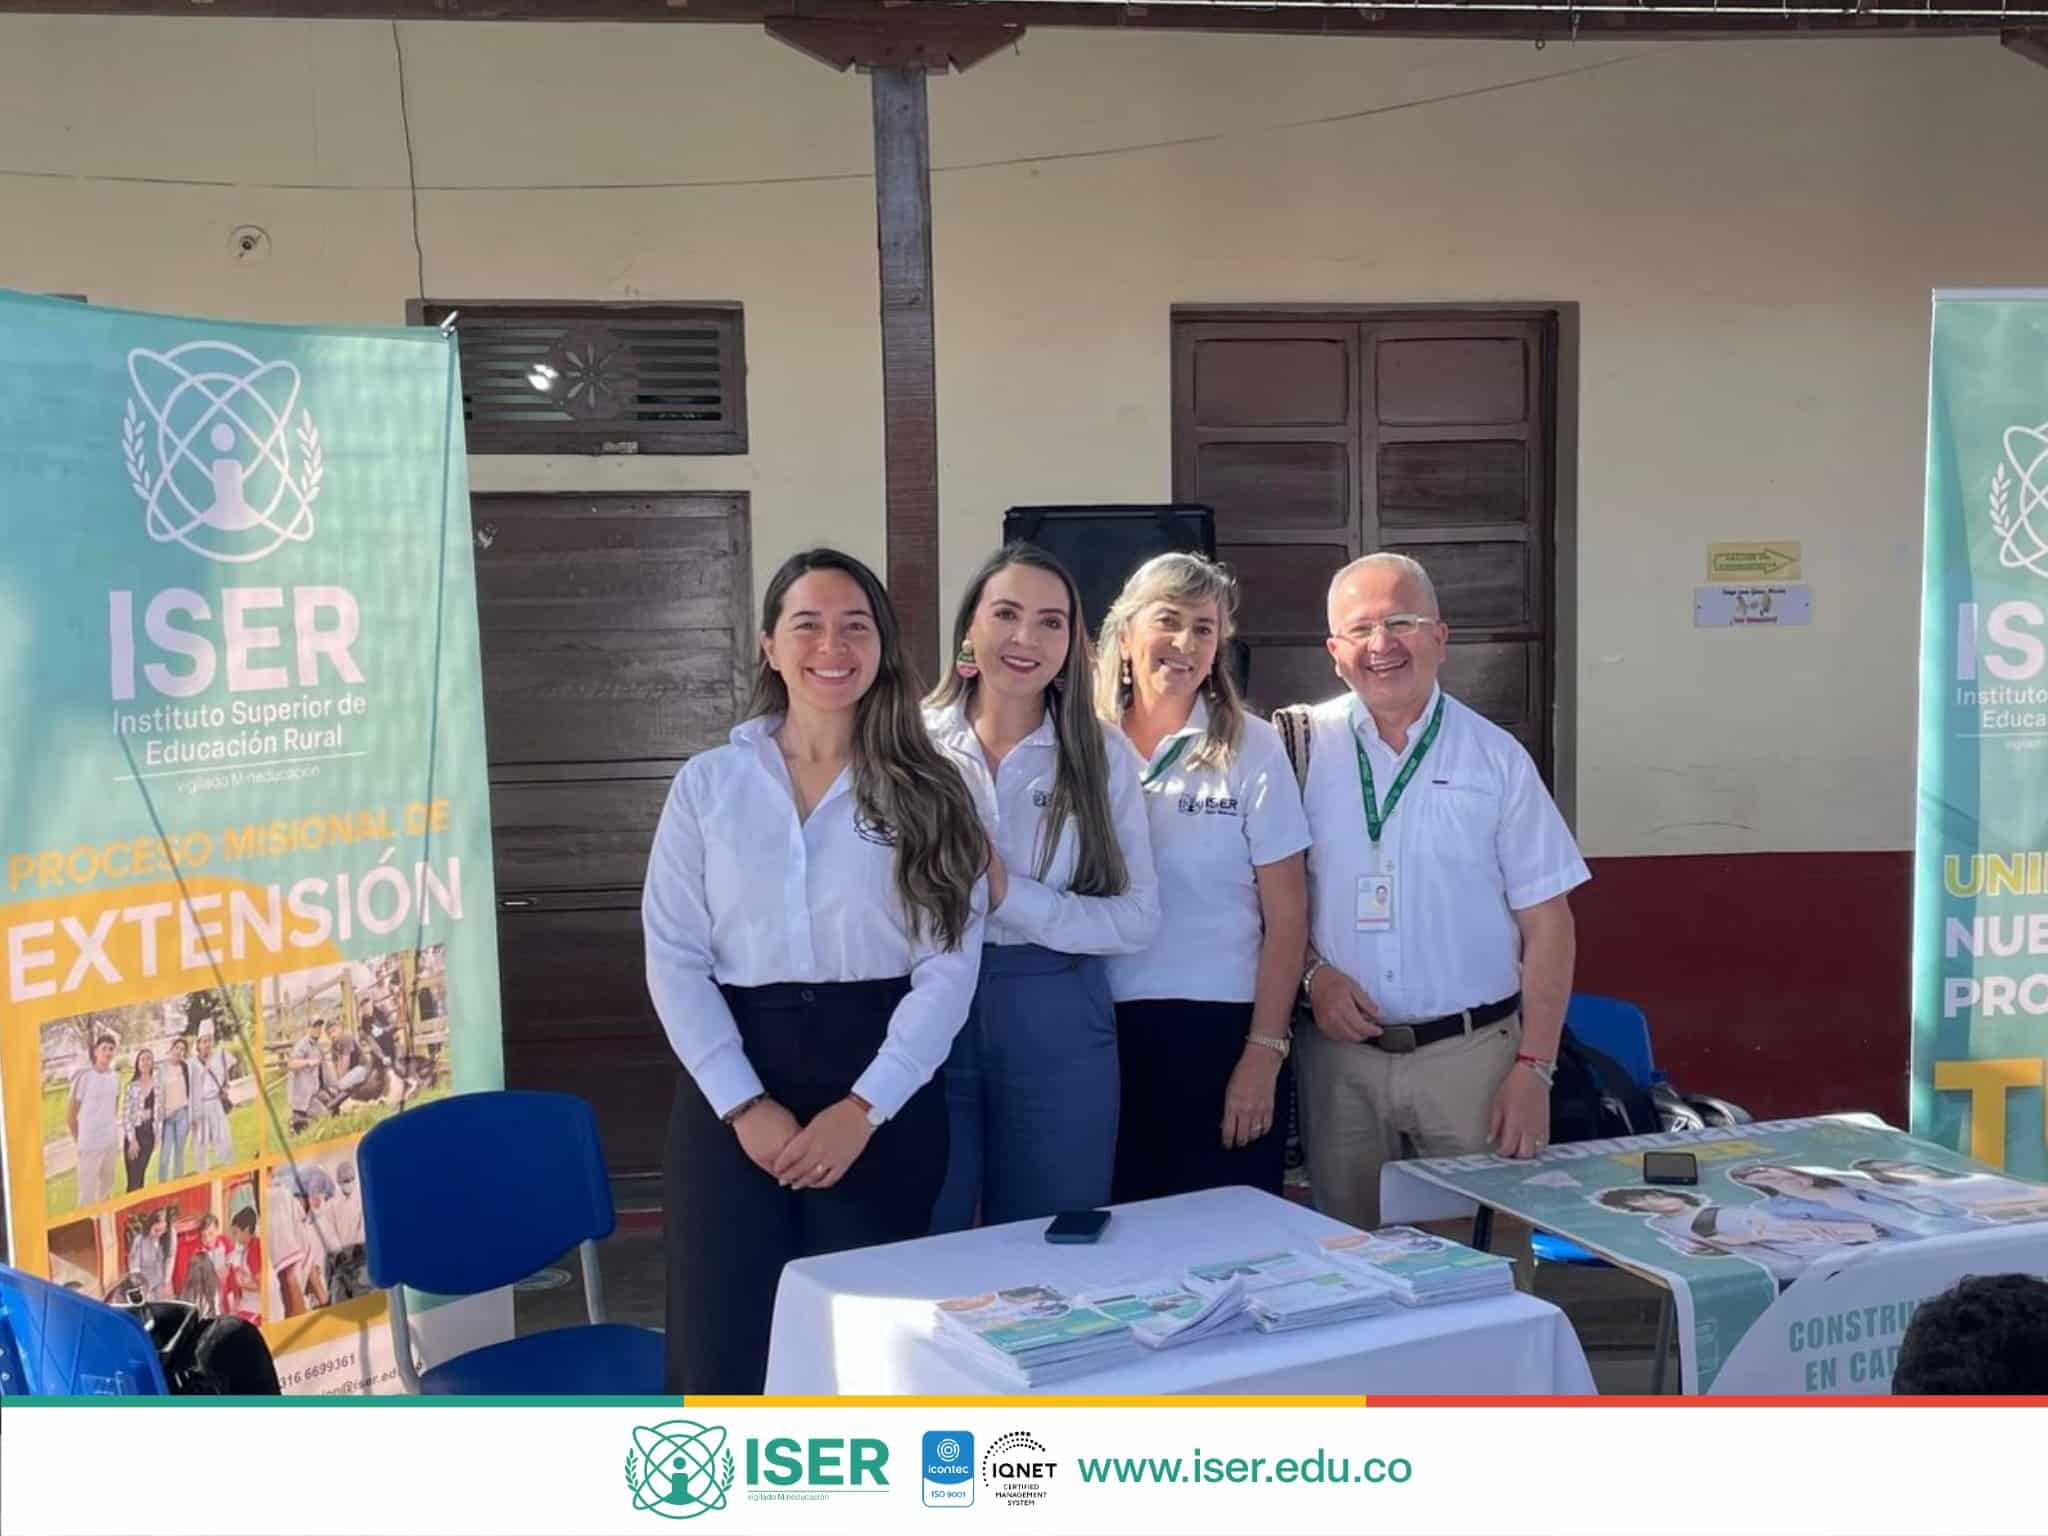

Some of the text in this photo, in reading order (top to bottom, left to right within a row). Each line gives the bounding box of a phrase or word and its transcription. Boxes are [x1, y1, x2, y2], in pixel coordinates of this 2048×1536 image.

[109, 585, 367, 701] ISER
[112, 693, 367, 736] Instituto Superior de
[1957, 687, 2048, 705] Instituto
[146, 723, 343, 765] Educación Rural
[8, 798, 449, 893] PROCESO MISIONAL DE
[1943, 852, 2048, 898] UNI
[8, 846, 464, 1003] EXTENSIÓN
[1806, 1357, 1837, 1392] EN
